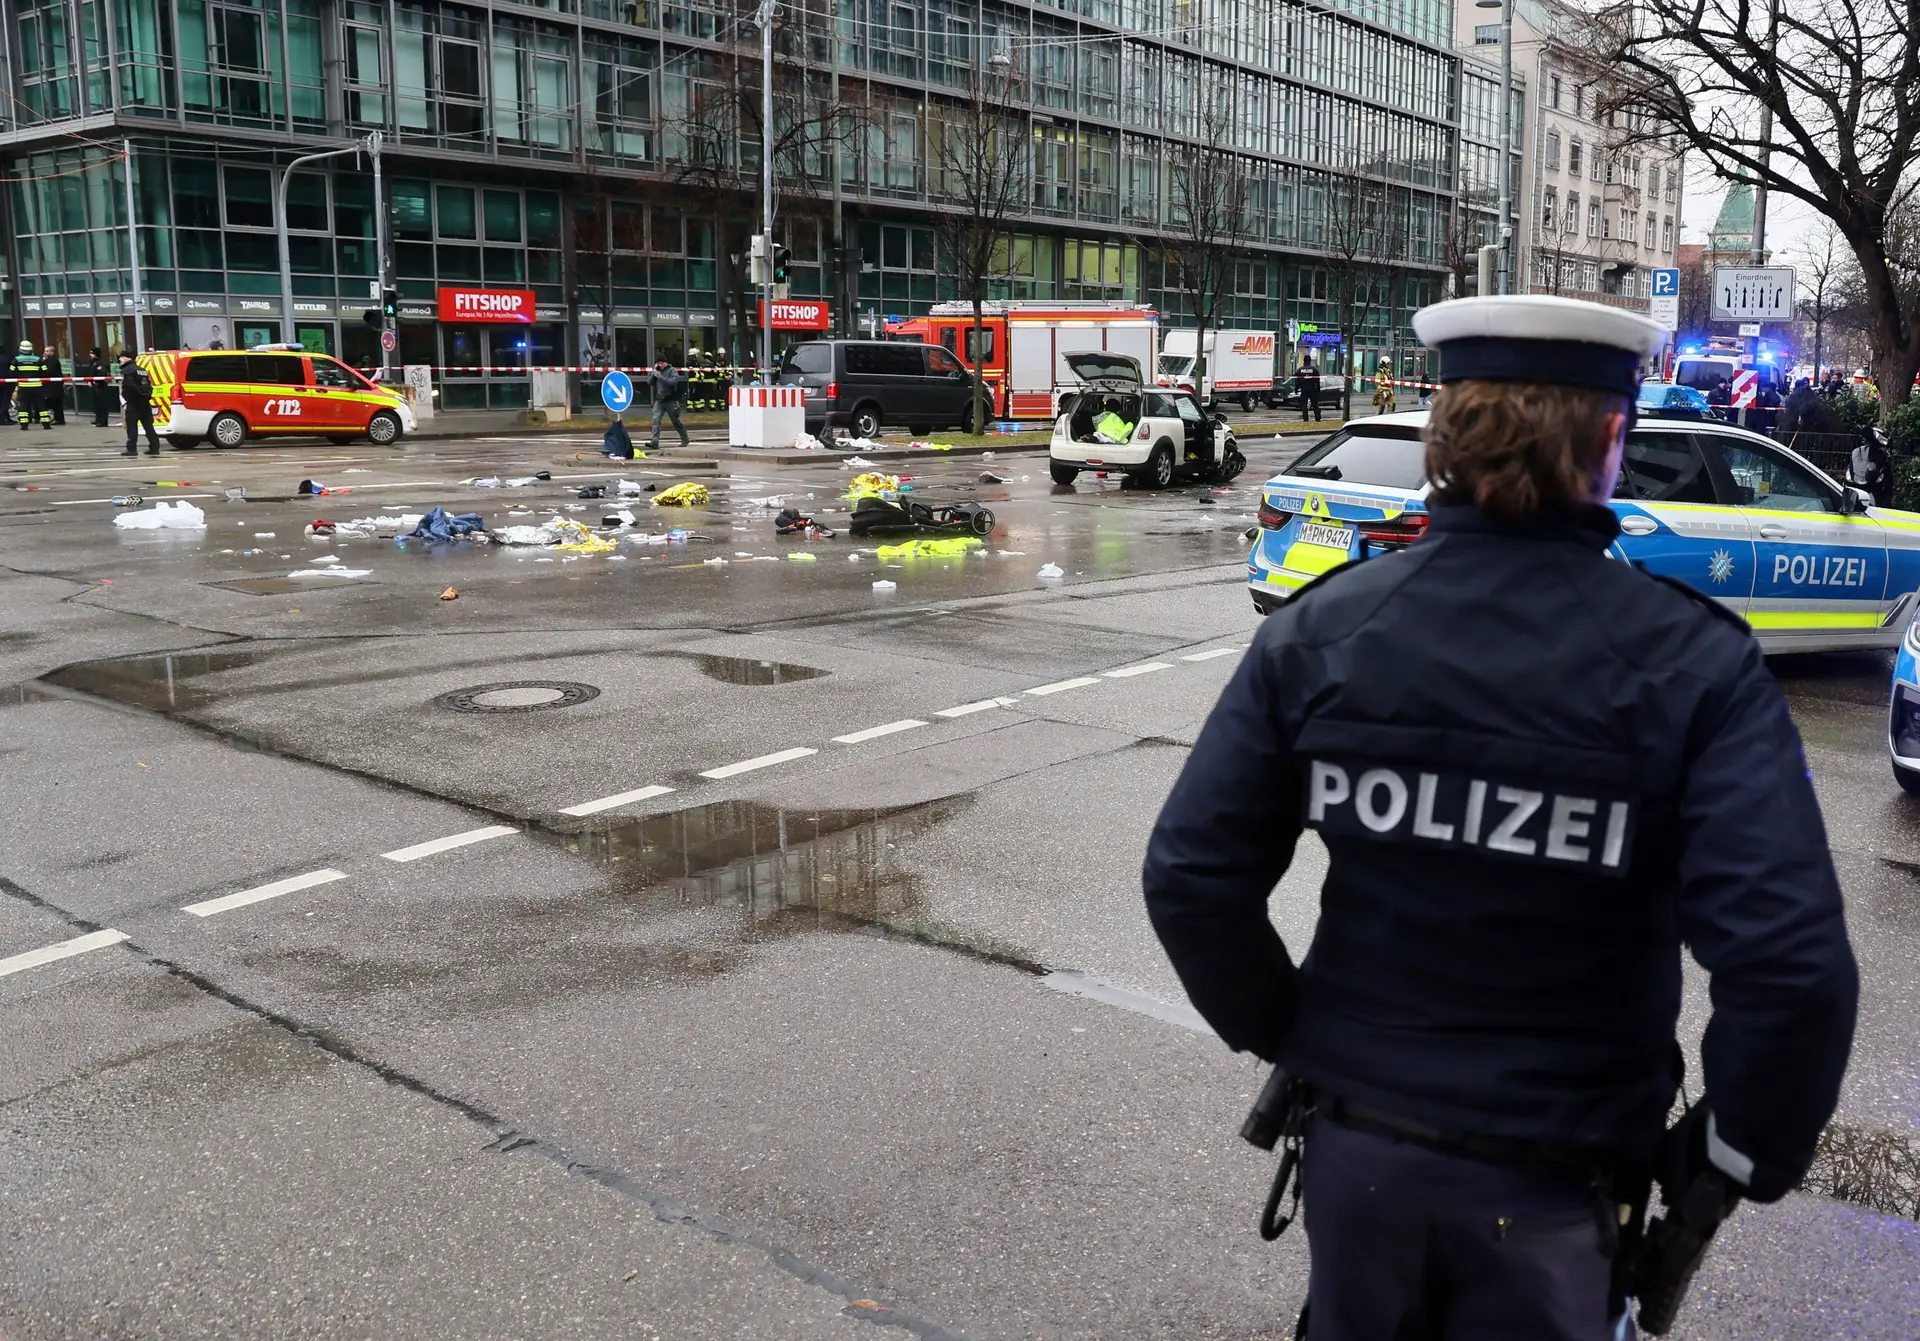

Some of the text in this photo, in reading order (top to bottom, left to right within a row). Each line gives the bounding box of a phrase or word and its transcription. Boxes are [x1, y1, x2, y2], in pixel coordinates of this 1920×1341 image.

[1735, 273, 1773, 281] Einordnen
[240, 300, 270, 310] TAURUS
[293, 303, 327, 311] KETTLER
[455, 293, 522, 311] FITSHOP
[771, 305, 819, 320] FITSHOP
[1244, 336, 1272, 353] AVM
[276, 399, 302, 416] 112
[1278, 497, 1302, 512] POLIZEI
[1301, 524, 1351, 547] M PM 9474
[1772, 554, 1866, 587] POLIZEI
[1308, 760, 1630, 867] POLIZEI
